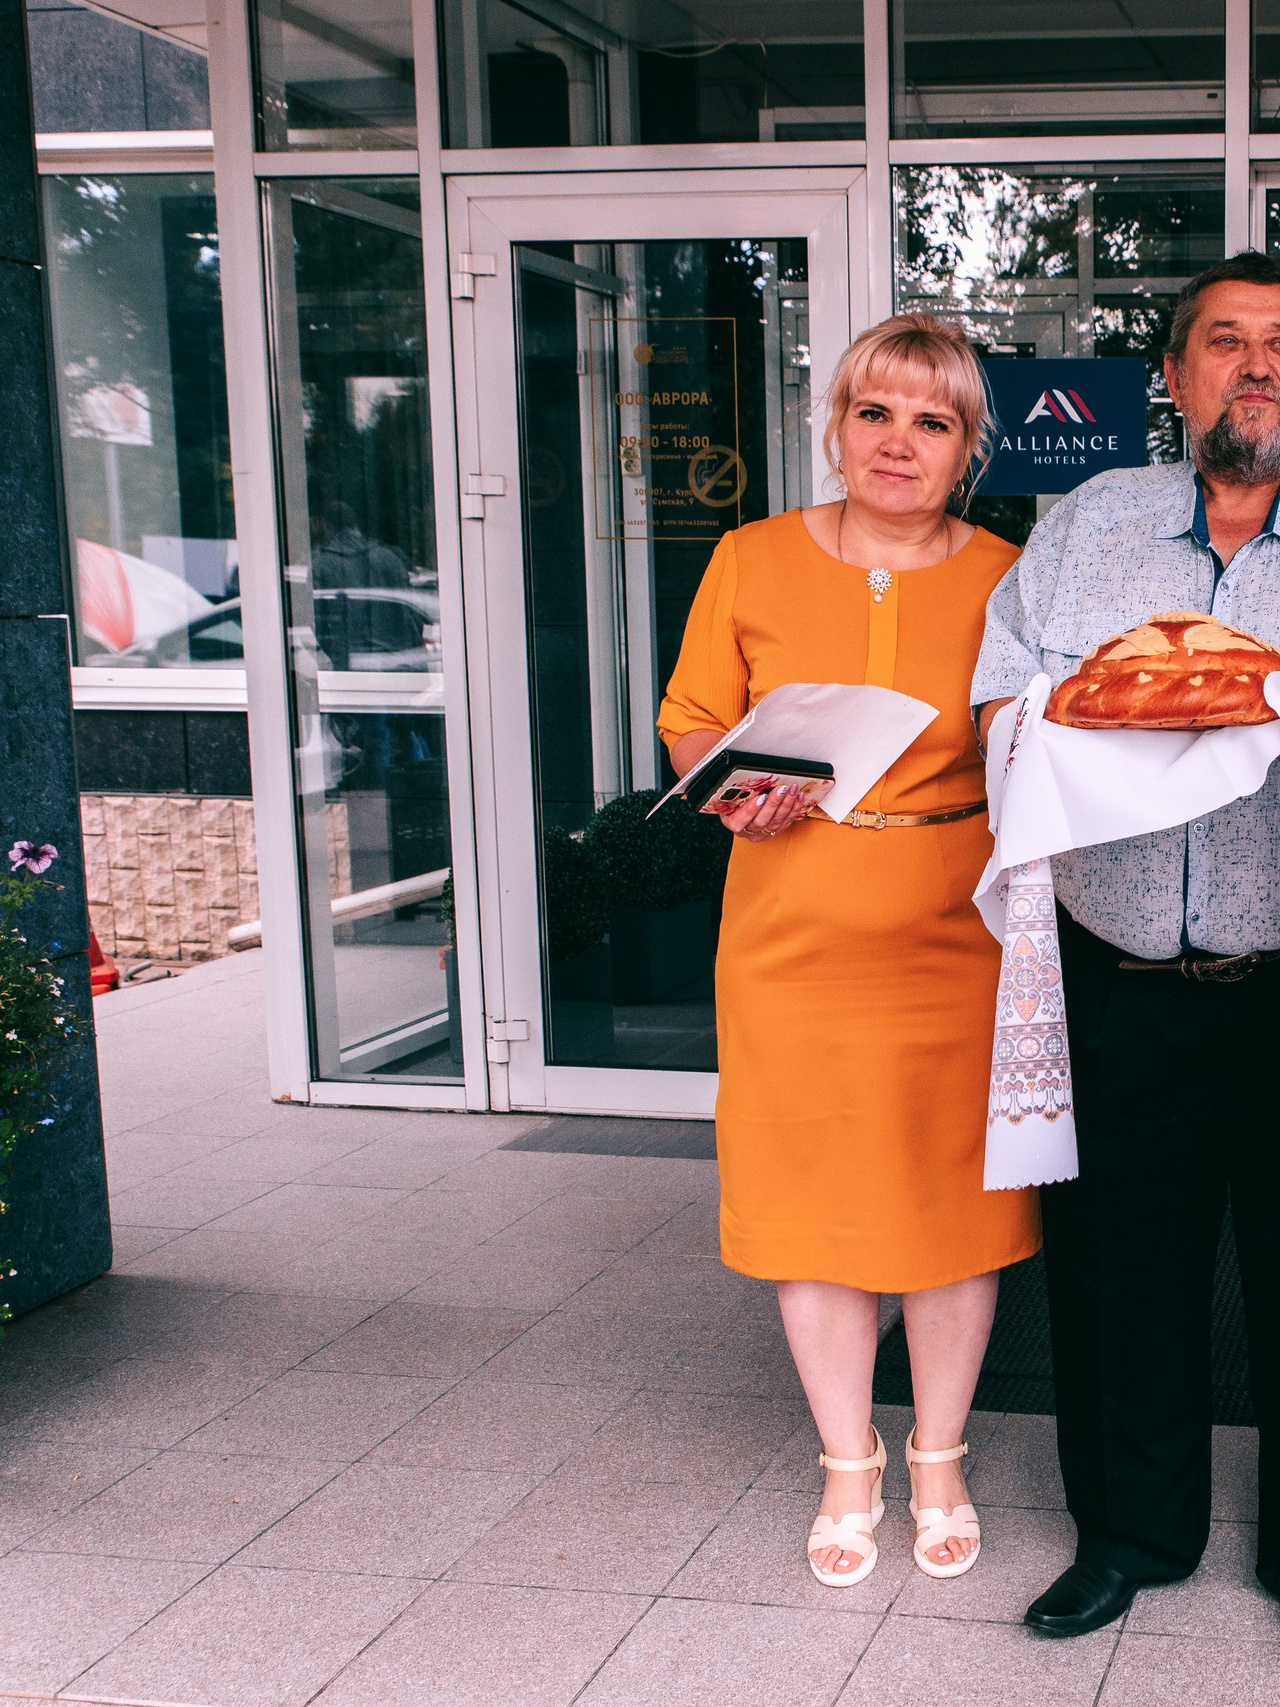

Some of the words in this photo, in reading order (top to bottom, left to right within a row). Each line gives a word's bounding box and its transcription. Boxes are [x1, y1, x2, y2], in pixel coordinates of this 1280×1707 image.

[615, 392, 645, 405] ООО
[672, 436, 710, 448] 18:00
[1000, 435, 1118, 451] ALLIANCE
[1034, 456, 1086, 465] HOTELS
[652, 498, 687, 506] Сумская,
